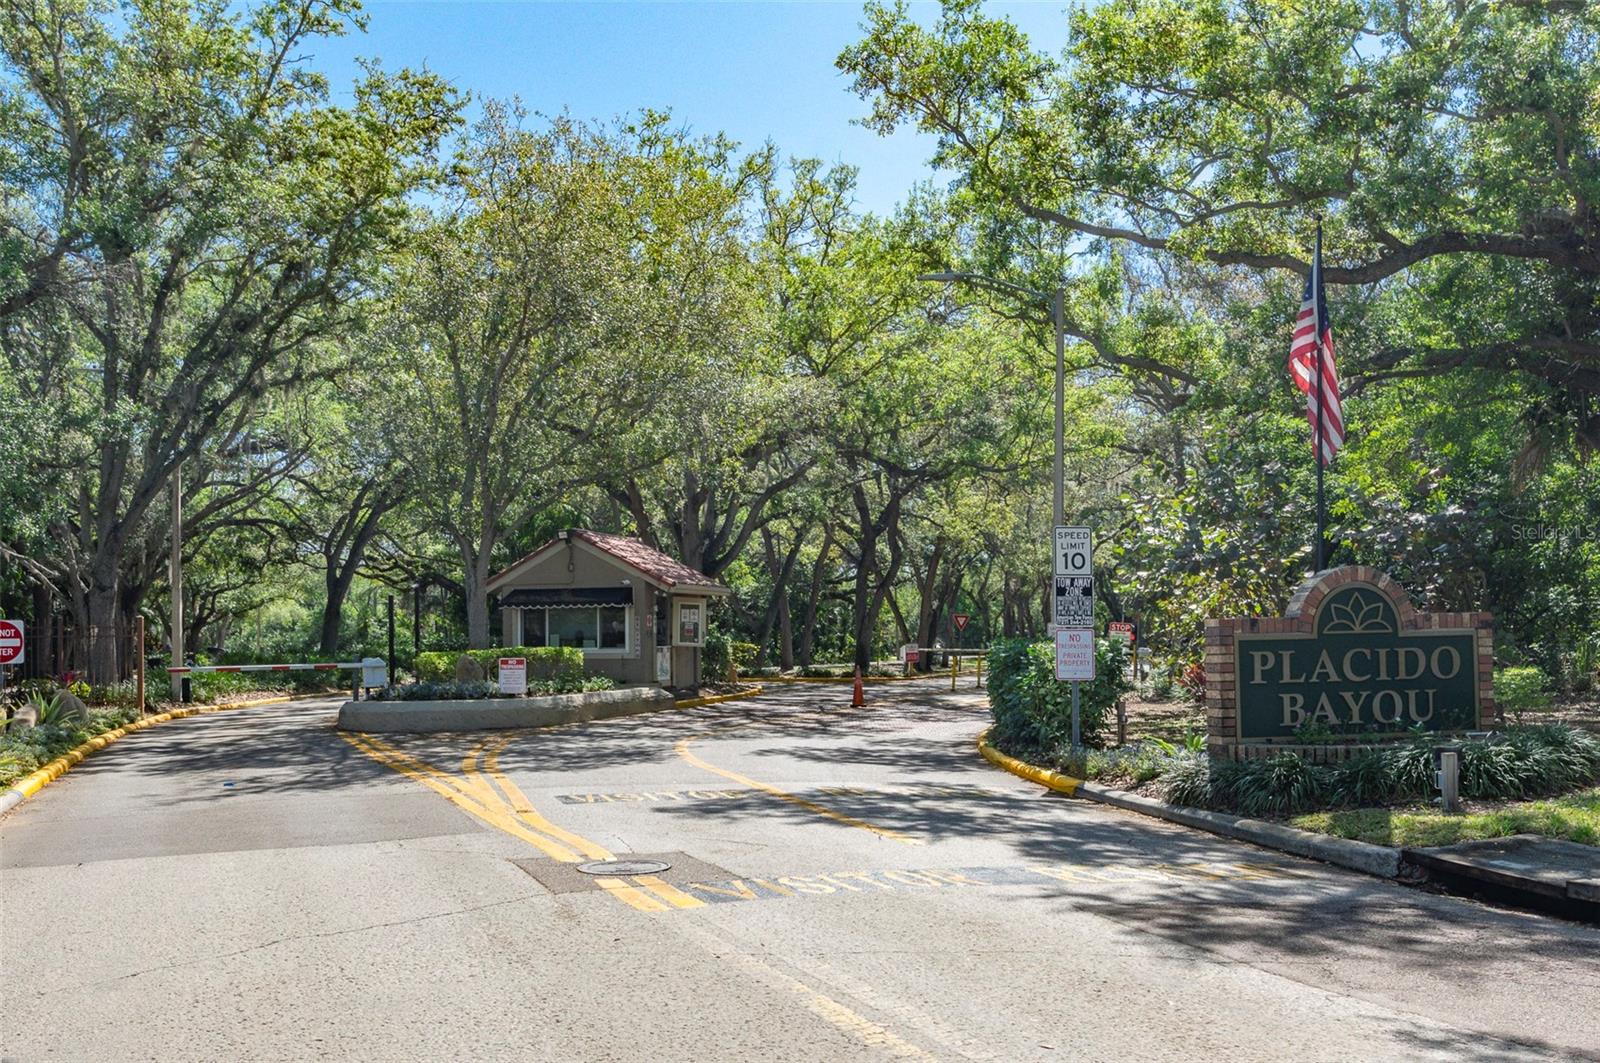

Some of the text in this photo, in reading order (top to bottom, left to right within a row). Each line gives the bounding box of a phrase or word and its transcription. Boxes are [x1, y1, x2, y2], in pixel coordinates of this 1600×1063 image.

[1057, 531, 1089, 540] SPEED
[1060, 542, 1086, 550] LIMIT
[1062, 552, 1086, 570] 10
[1057, 577, 1091, 587] TOW AWAY
[1065, 587, 1084, 597] ZONE
[1110, 623, 1131, 632] STOP
[1069, 633, 1081, 642] NO
[1249, 645, 1462, 685] PLACIDO
[1279, 688, 1437, 727] BAYOU
[687, 868, 991, 899] VISITOR
